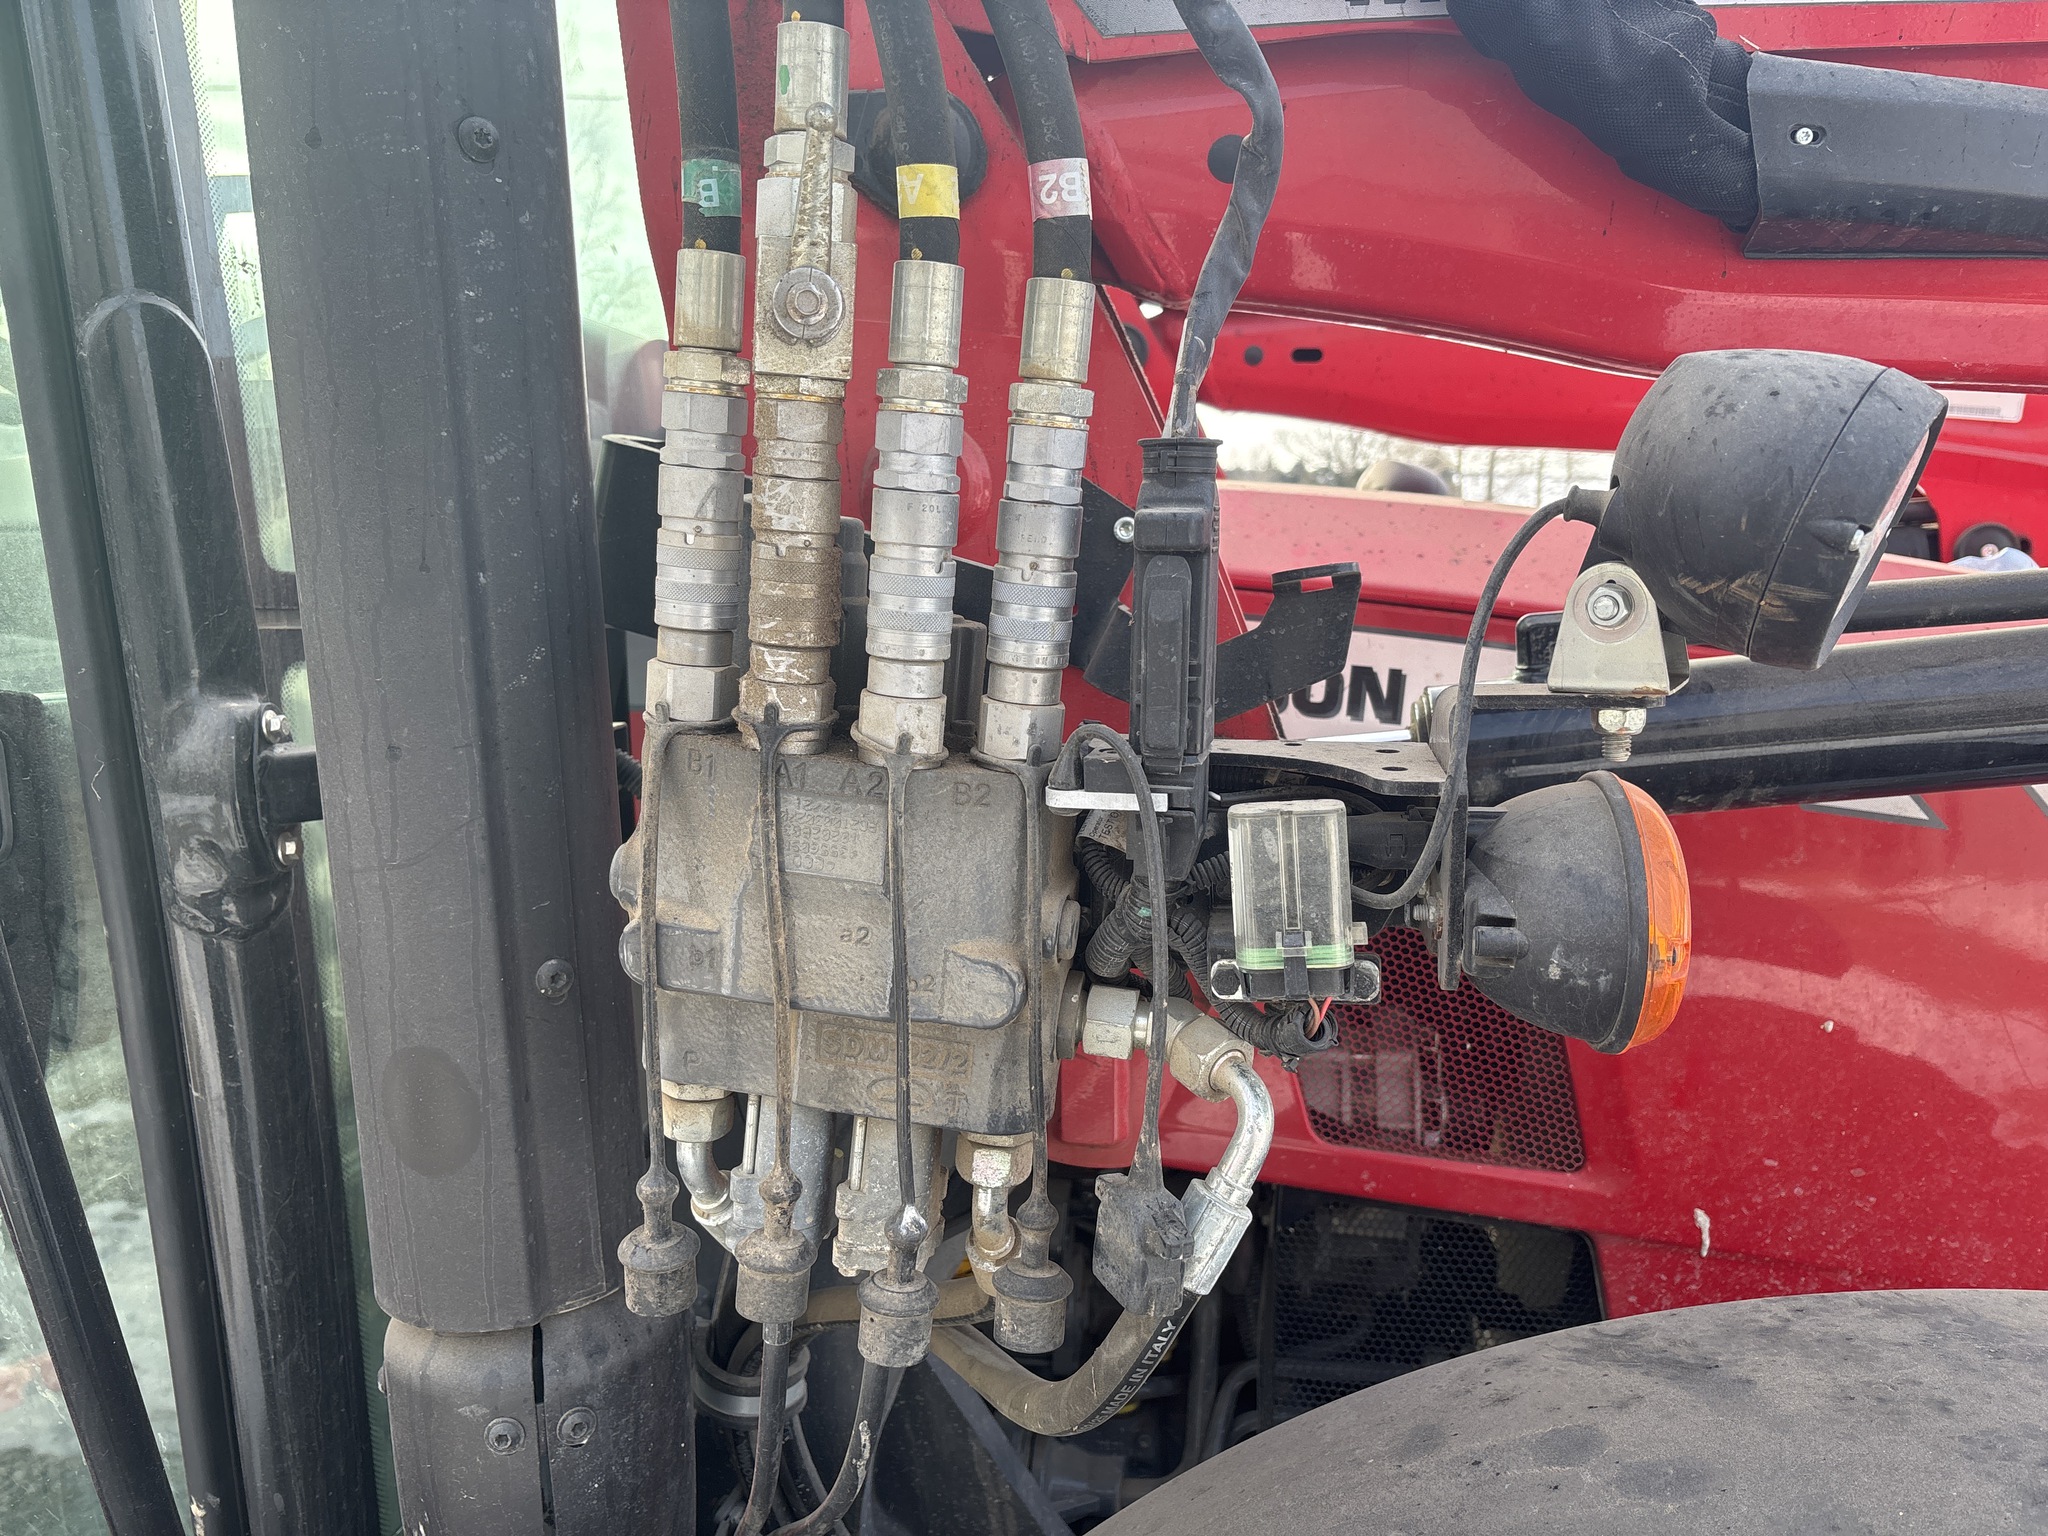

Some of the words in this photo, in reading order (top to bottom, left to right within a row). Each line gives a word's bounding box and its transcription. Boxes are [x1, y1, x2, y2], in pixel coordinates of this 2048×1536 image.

[1039, 172, 1083, 204] B2
[1278, 665, 1407, 725] ON
[839, 767, 884, 797] A2
[953, 781, 990, 807] B2
[1098, 818, 1115, 839] TEST
[1101, 1384, 1137, 1419] MADE
[1128, 1367, 1149, 1383] IN
[1141, 1319, 1177, 1366] ITALY
